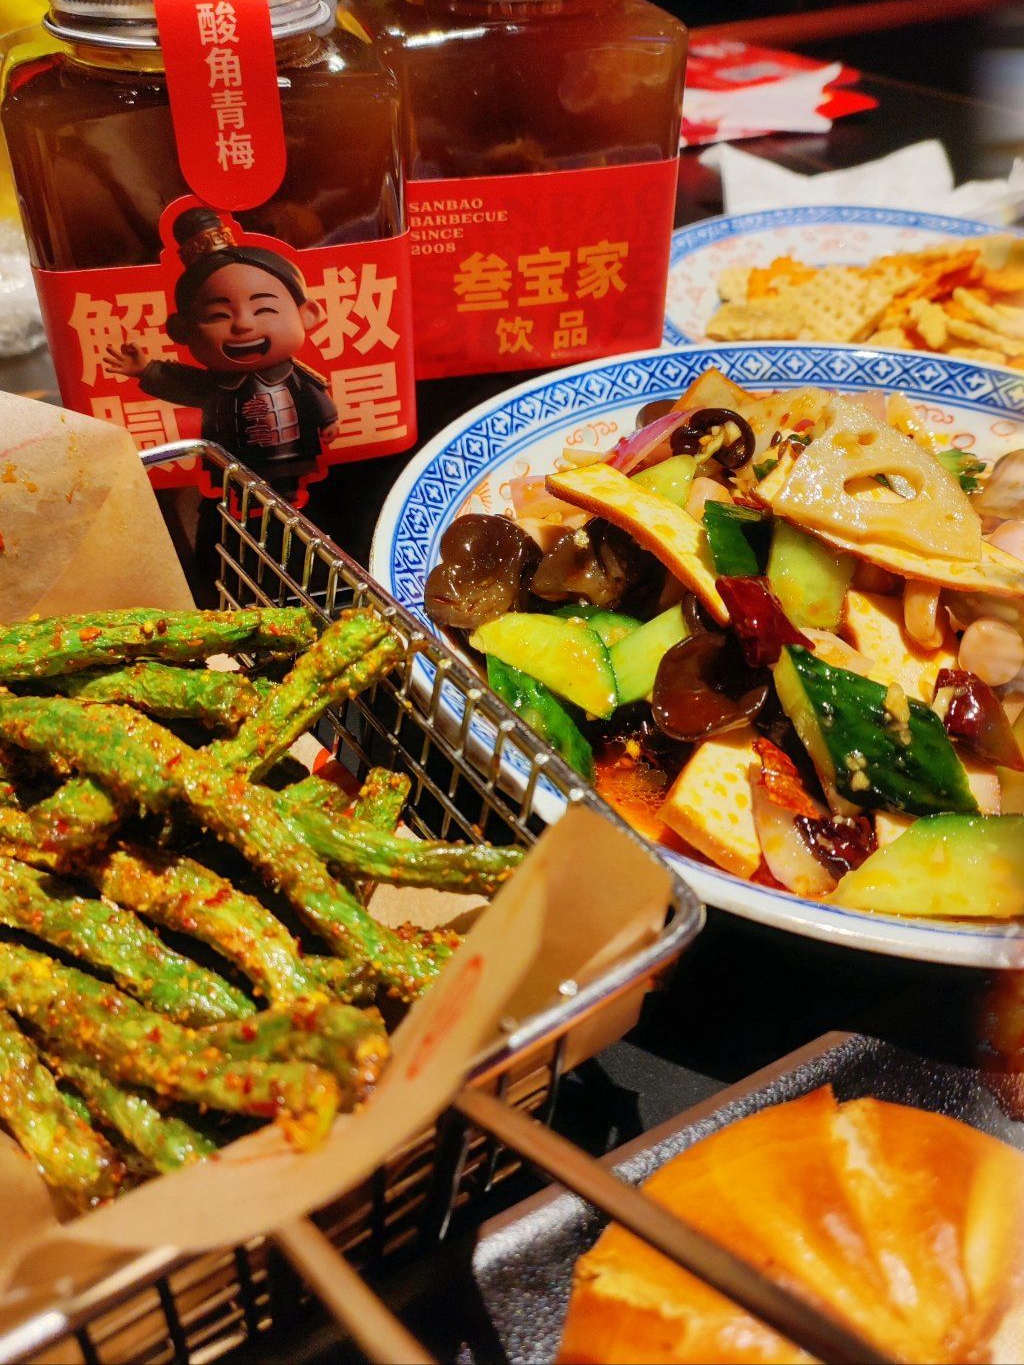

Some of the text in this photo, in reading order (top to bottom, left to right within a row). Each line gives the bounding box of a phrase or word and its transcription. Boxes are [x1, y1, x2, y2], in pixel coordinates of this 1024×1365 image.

[196, 1, 255, 171] 酸角青梅
[408, 198, 483, 213] SANBAO
[410, 211, 508, 227] BARBECUE
[411, 228, 464, 241] SINCE
[411, 242, 456, 256] 2008
[453, 239, 629, 312] 叁宝家
[495, 309, 588, 354] 饮品
